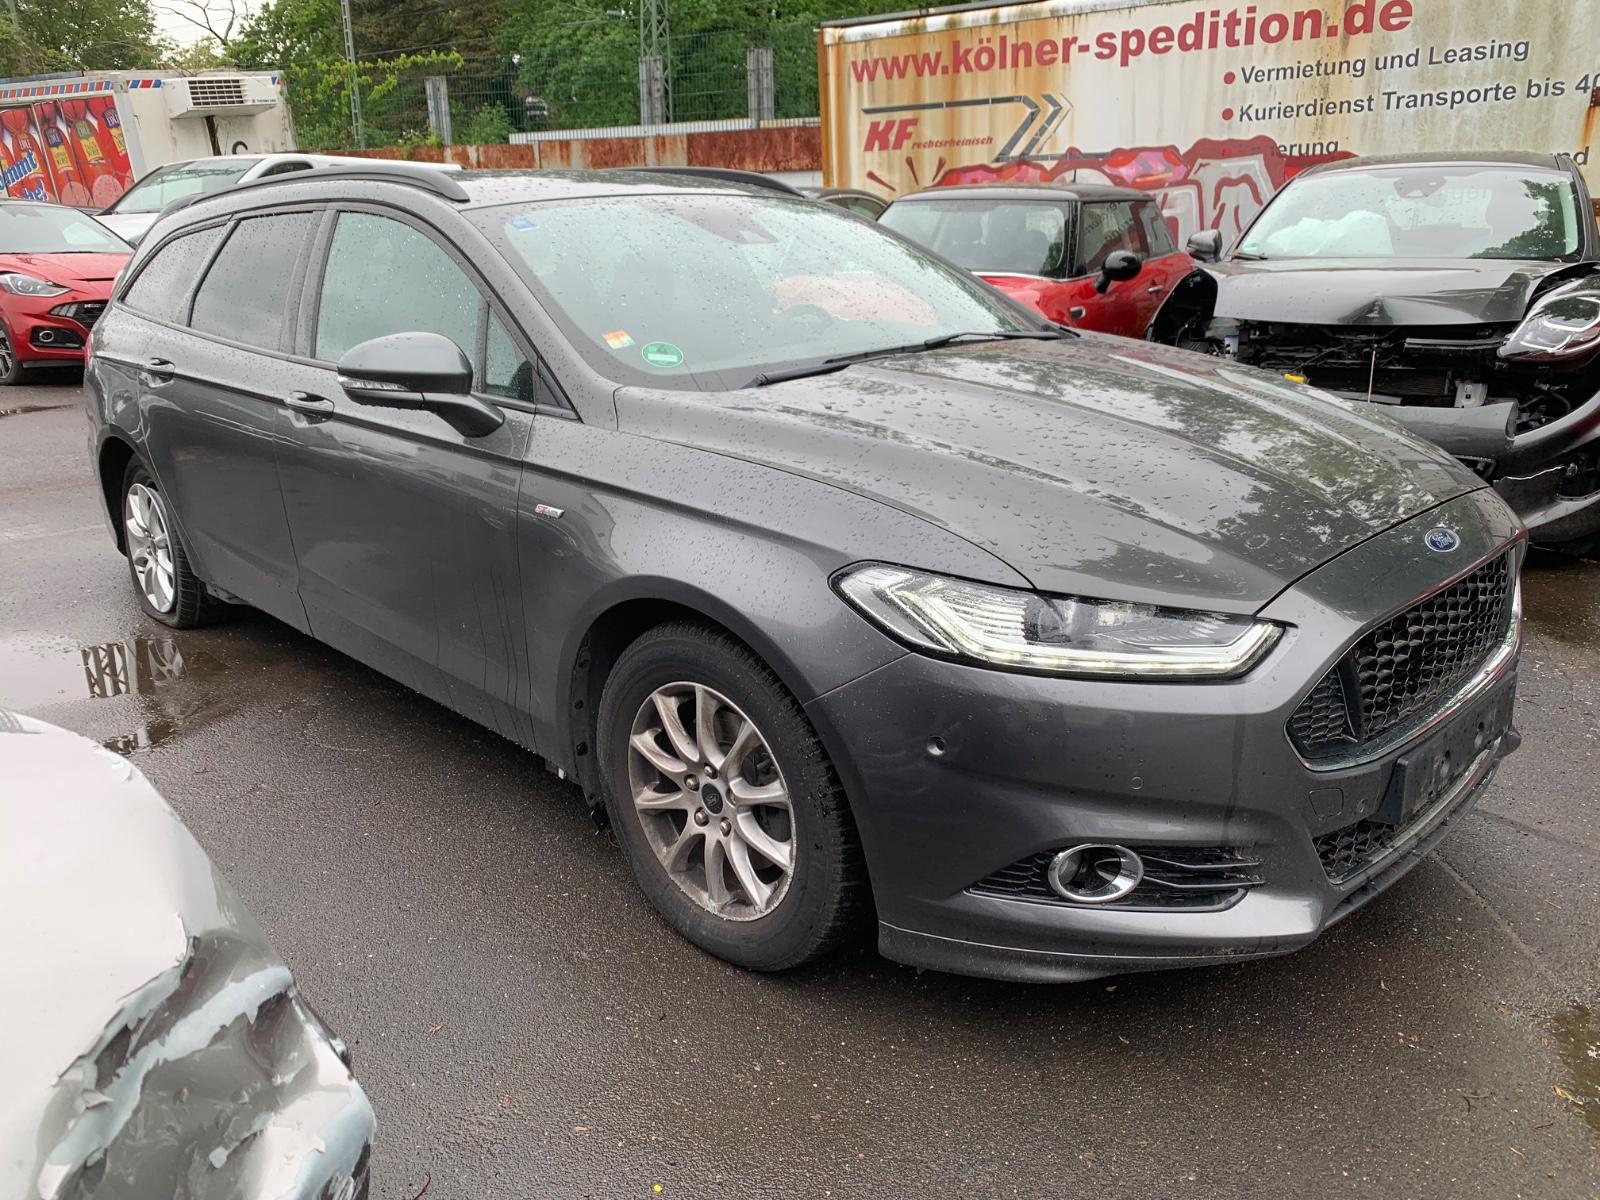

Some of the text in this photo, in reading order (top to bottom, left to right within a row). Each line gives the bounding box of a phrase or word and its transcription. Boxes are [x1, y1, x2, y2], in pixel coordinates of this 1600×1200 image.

[851, 0, 1413, 83] www.kölner-spedition.de
[1240, 38, 1531, 85] Vermietung und Leasing
[1238, 73, 1600, 122] Kurierdienst Transporte bis 4
[864, 118, 919, 152] KF
